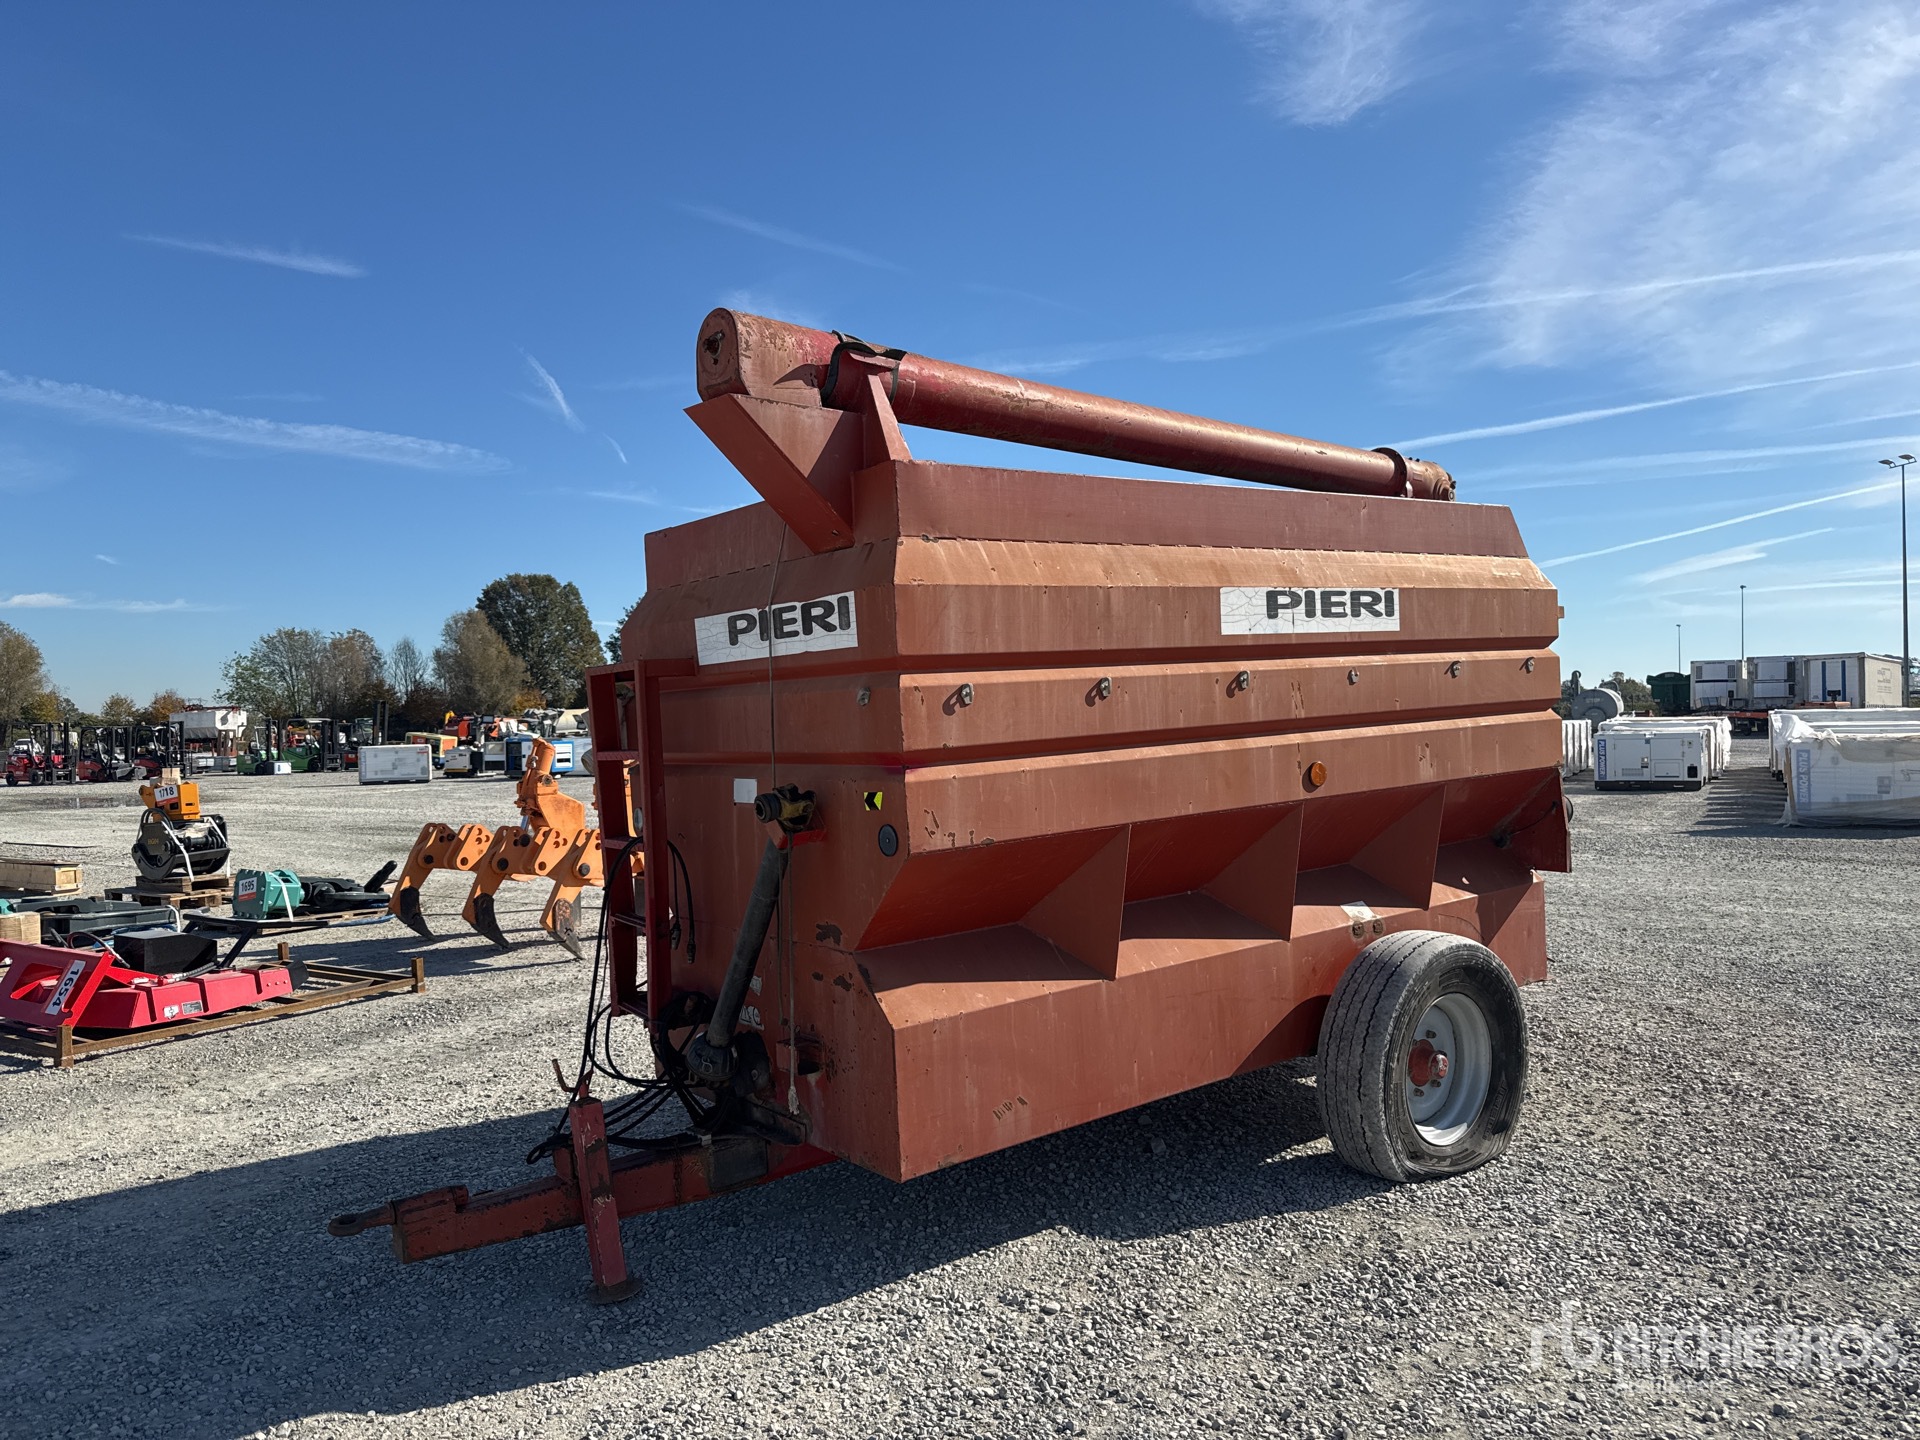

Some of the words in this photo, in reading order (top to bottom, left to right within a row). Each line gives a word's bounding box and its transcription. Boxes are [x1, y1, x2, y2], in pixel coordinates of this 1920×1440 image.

[1266, 590, 1395, 619] PIERI
[727, 595, 851, 646] PIERI
[1598, 740, 1606, 755] PLUS
[1798, 751, 1808, 775] PLUS
[159, 786, 175, 798] 1718
[1799, 774, 1809, 803] POWER
[241, 880, 255, 892] 1695
[52, 968, 80, 1007] 1654
